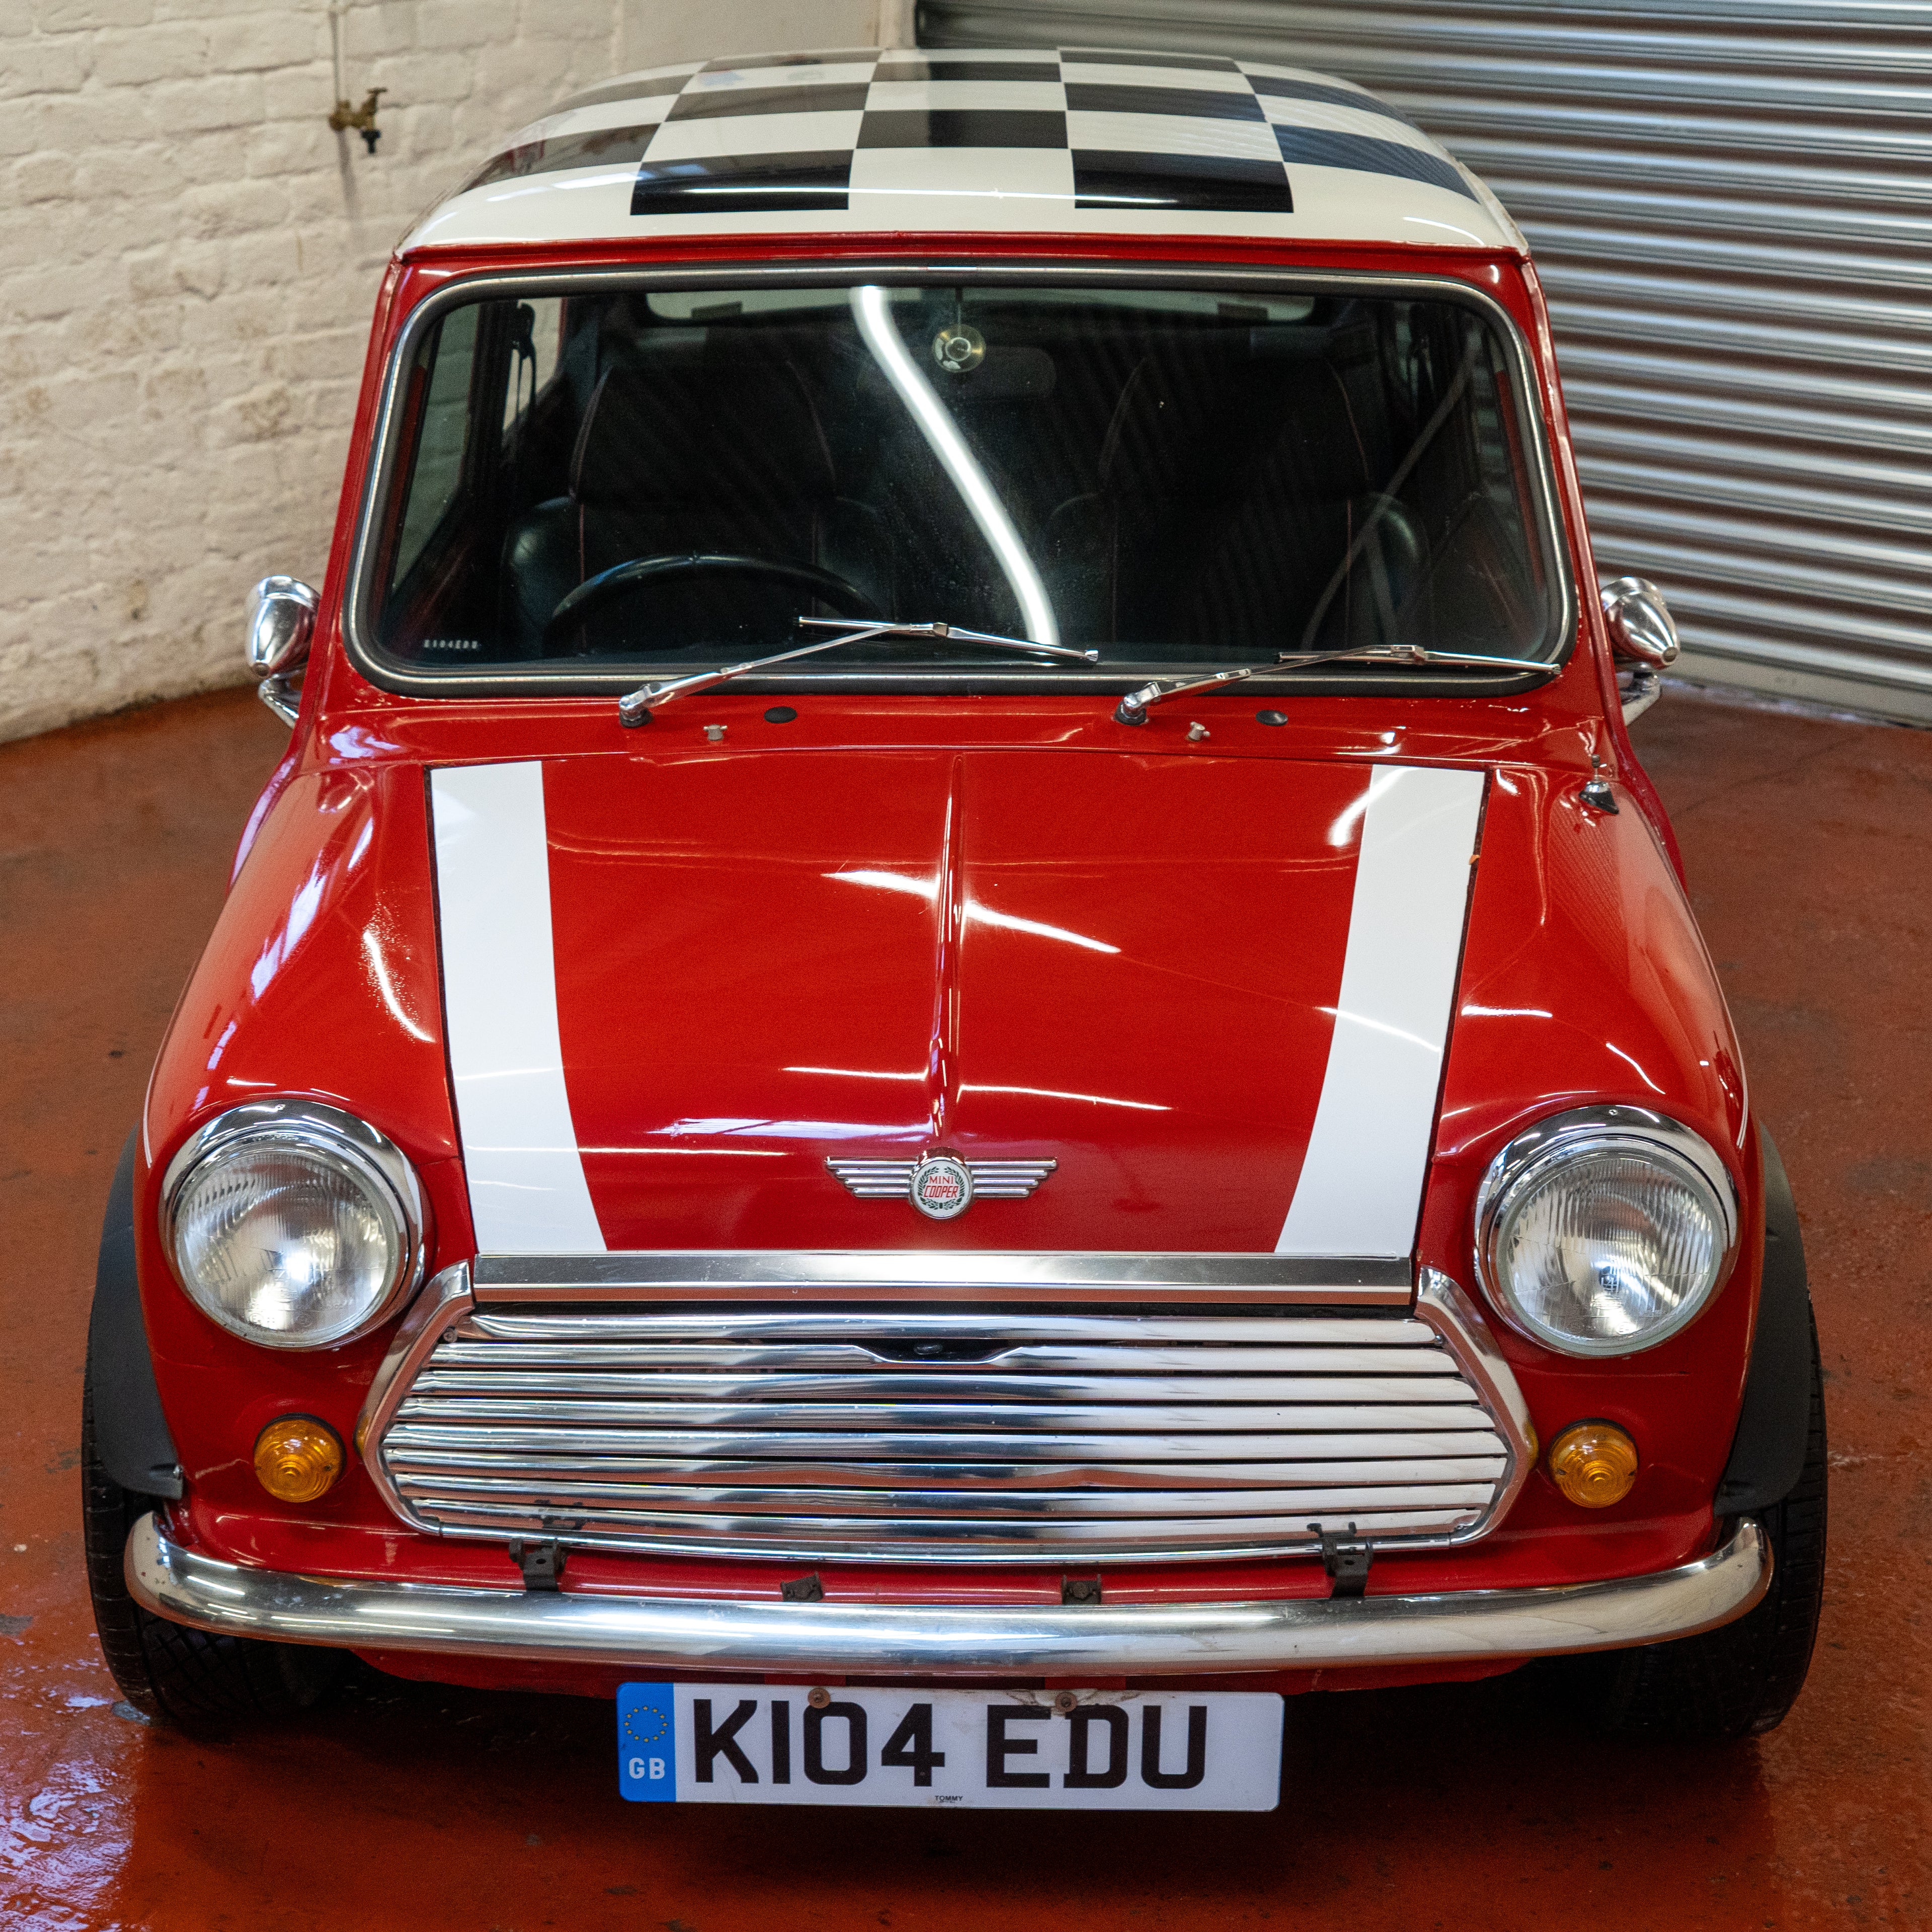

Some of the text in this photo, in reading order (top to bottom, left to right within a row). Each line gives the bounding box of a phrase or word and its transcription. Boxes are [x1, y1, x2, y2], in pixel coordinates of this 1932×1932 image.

[929, 1176, 954, 1184] MINI
[923, 1185, 959, 1198] COOPER
[986, 1704, 1208, 1789] EDU
[628, 1757, 665, 1780] GB
